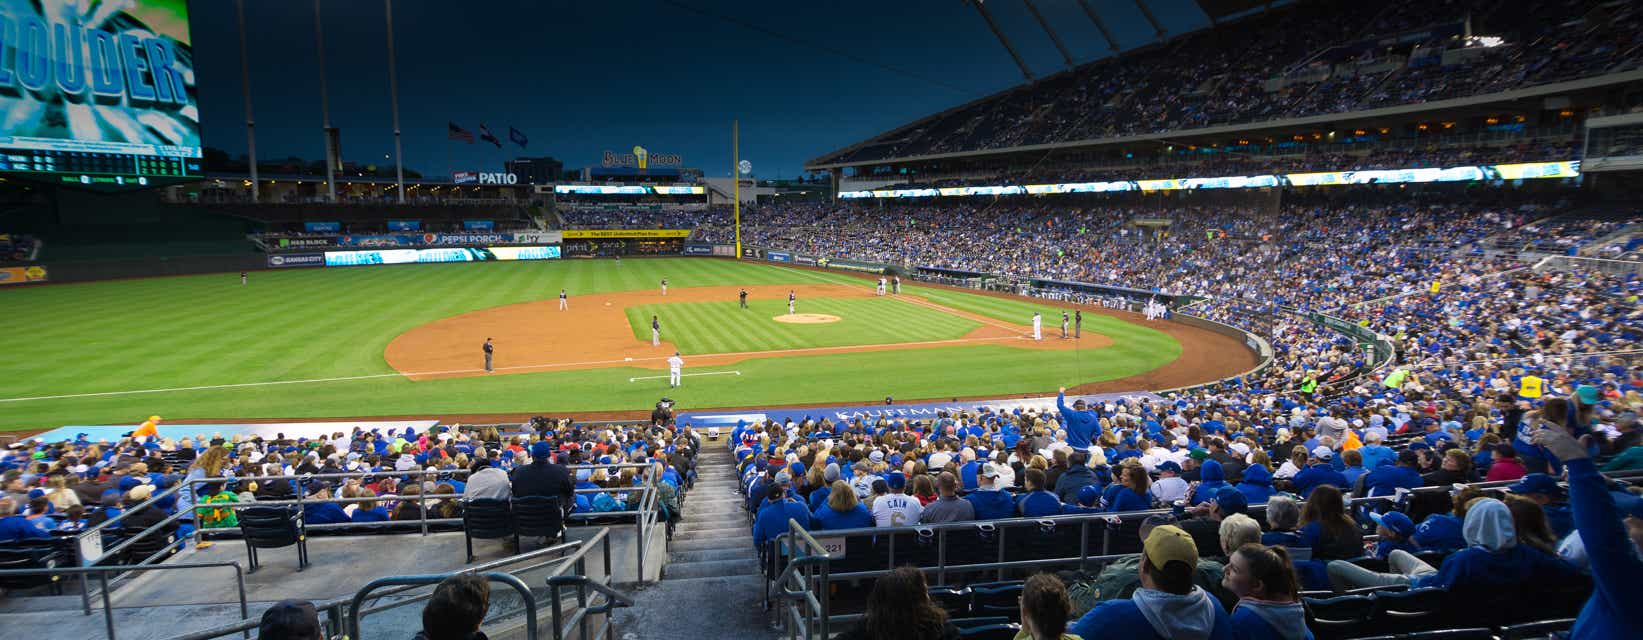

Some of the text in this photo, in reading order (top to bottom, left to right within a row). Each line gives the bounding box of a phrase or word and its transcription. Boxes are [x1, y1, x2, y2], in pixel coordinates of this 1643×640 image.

[0, 13, 188, 104] LOUDER
[602, 151, 682, 167] BLUE MOON
[479, 172, 518, 185] PATIO
[441, 234, 502, 243] PEPSI PORCH
[835, 406, 964, 419] KAUFFMAN
[887, 499, 907, 509] CAIN
[824, 543, 842, 553] 221
